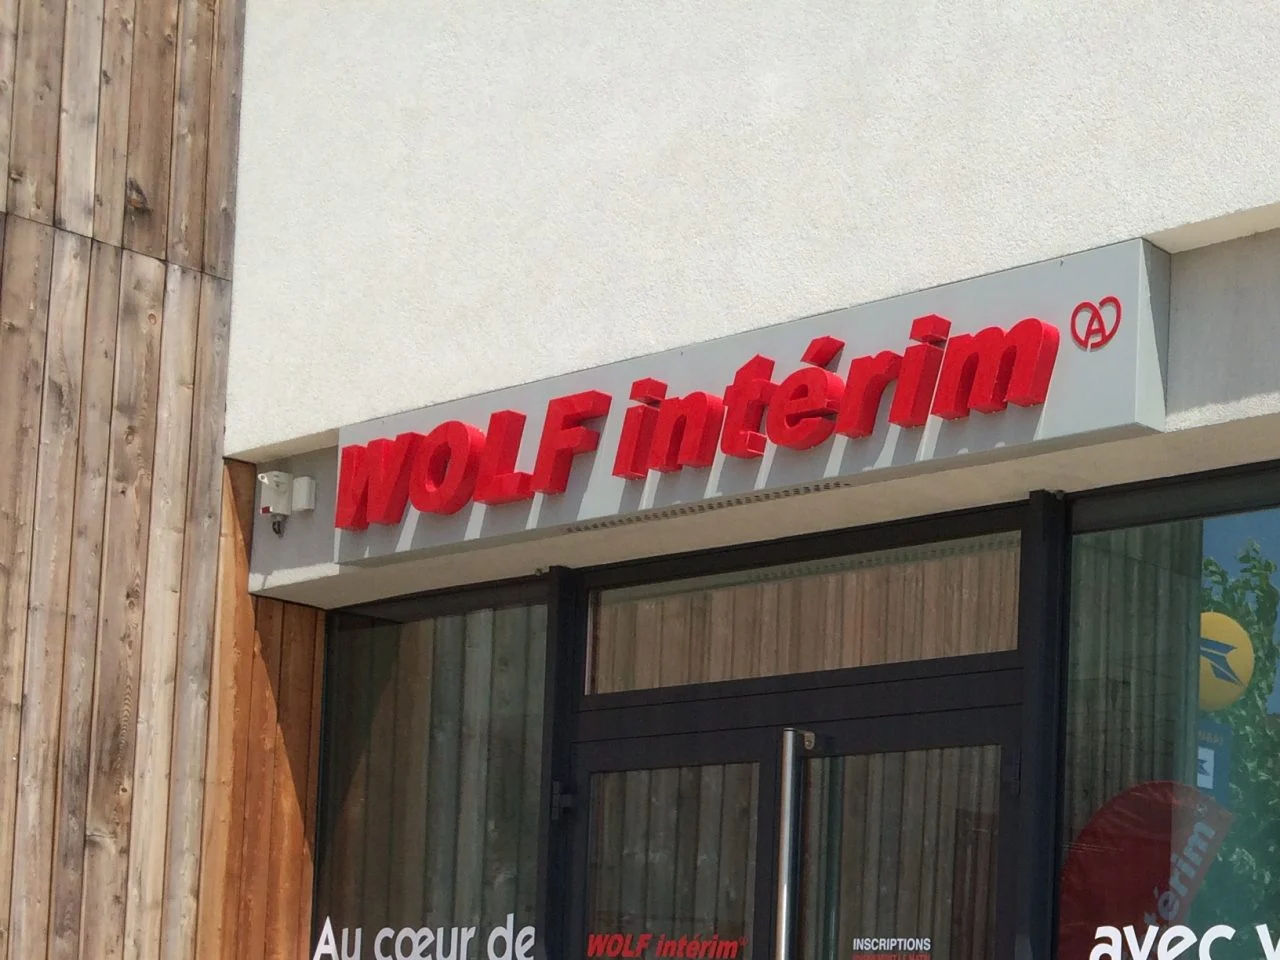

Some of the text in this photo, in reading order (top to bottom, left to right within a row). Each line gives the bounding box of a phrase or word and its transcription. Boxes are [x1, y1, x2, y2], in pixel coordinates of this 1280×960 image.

[335, 313, 1061, 532] WOLF intérim
[587, 933, 739, 959] WOLF intérim
[853, 938, 931, 951] INSCRIPTIONS
